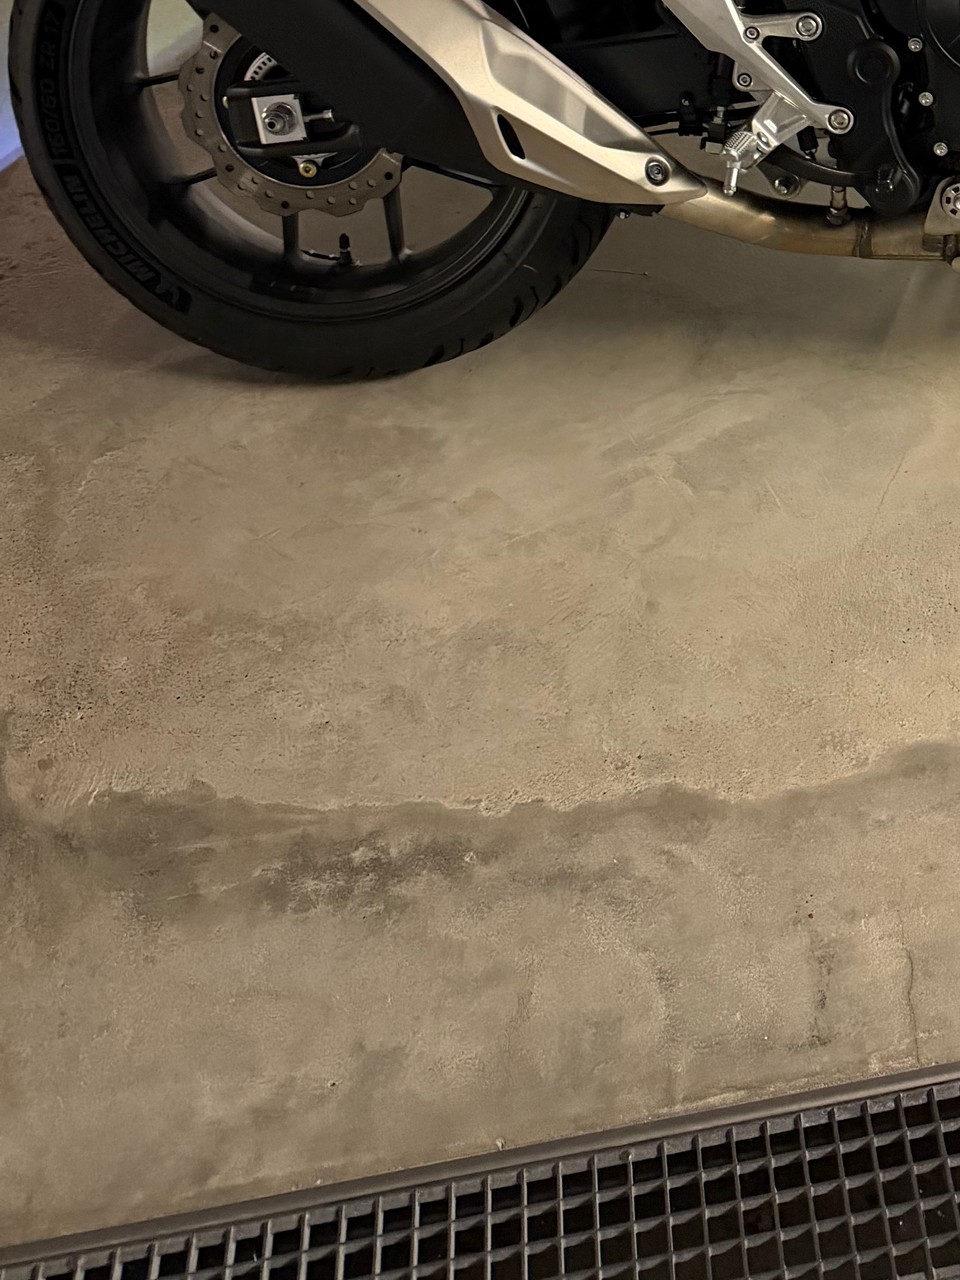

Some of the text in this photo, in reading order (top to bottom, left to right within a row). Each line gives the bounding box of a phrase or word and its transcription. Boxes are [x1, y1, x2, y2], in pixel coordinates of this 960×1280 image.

[39, 11, 69, 158] 160/60 ZR 17
[61, 174, 157, 282] MICHELIN
